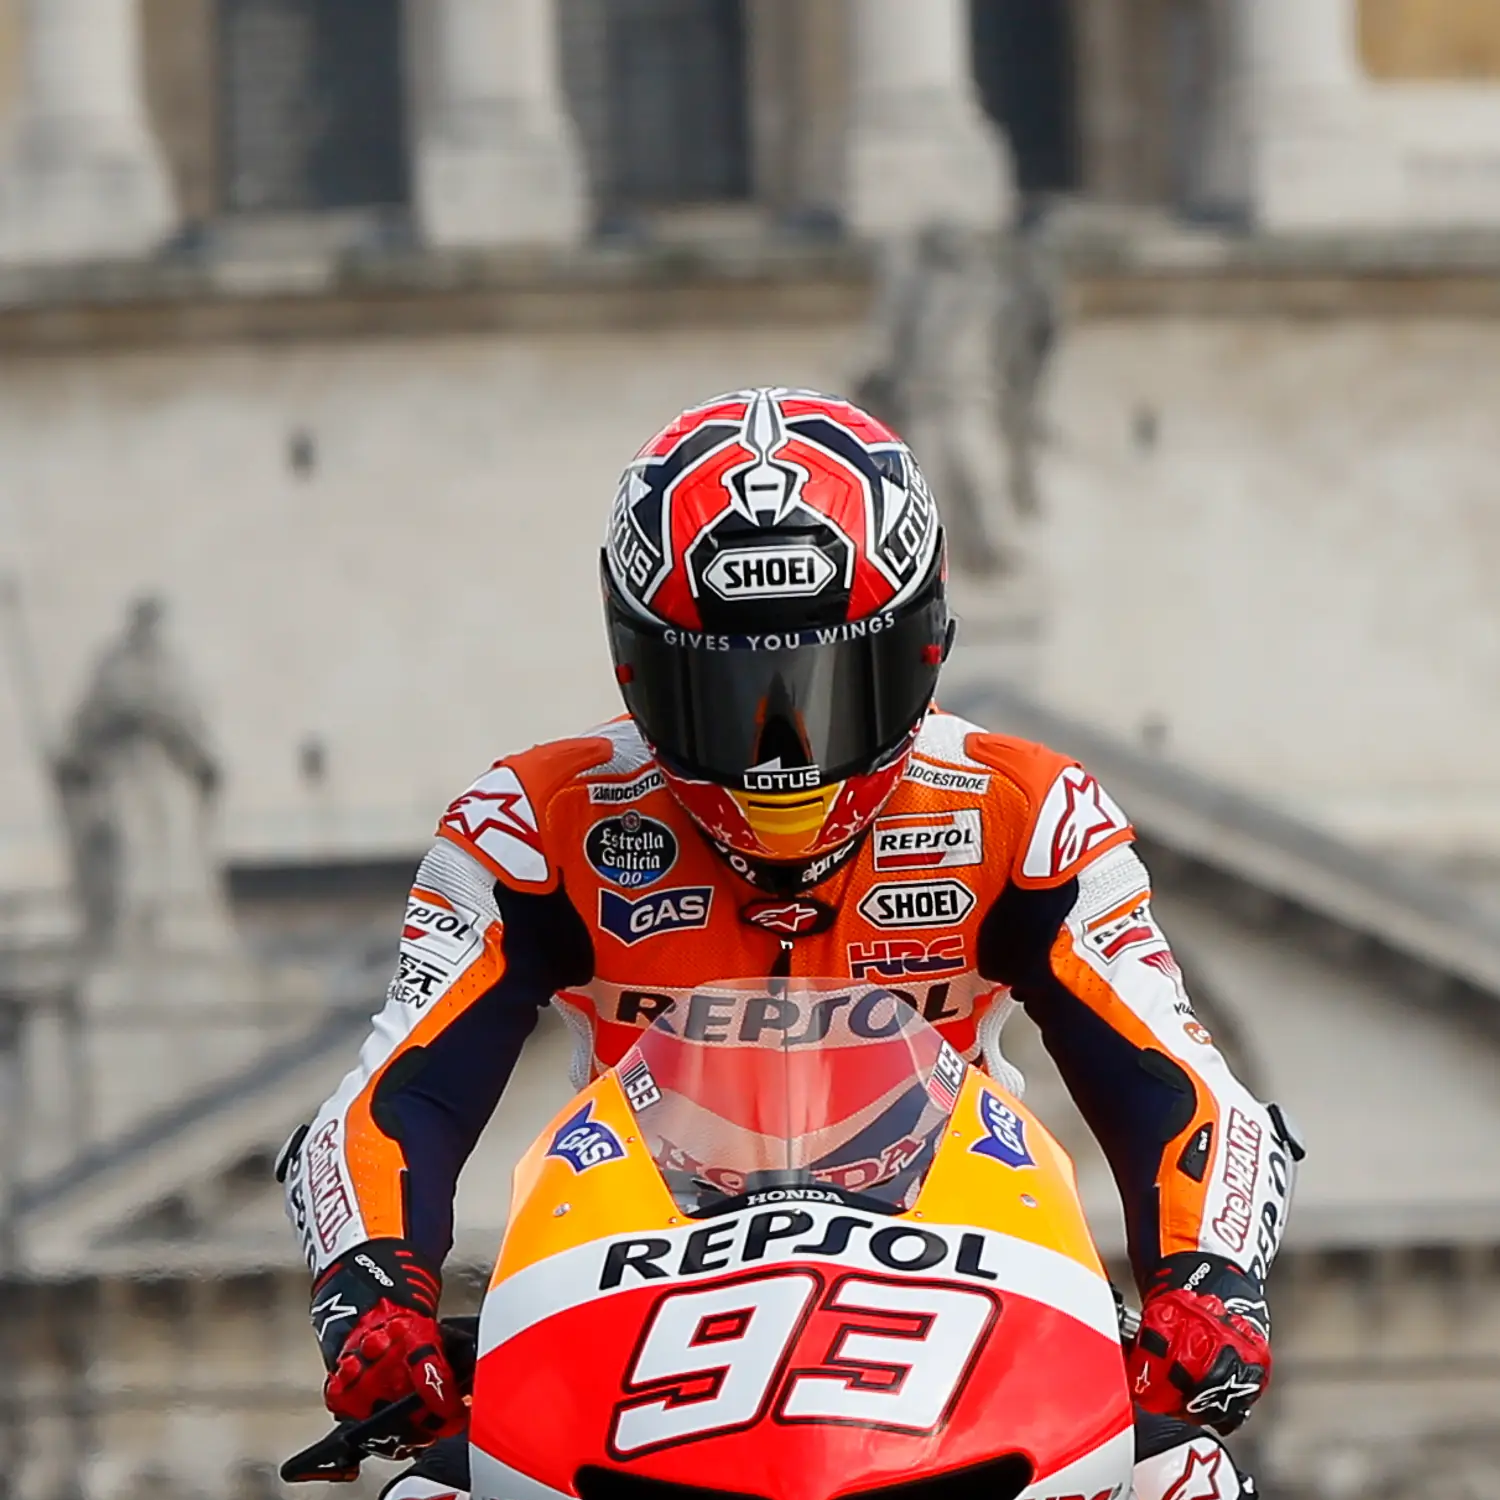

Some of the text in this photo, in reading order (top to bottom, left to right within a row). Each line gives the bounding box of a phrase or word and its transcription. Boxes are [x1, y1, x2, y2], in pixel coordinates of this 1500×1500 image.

[884, 466, 930, 575] LOTUS
[612, 492, 653, 588] OTUS
[723, 556, 816, 589] SHOEI
[663, 611, 895, 652] GIVES YOU WINGS
[592, 772, 665, 801] BRIDGESTO
[743, 770, 821, 790] LOTUS
[904, 764, 986, 790] IDGESTONE
[599, 828, 664, 851] Estrella
[602, 847, 660, 870] Galicia
[879, 829, 975, 851] REPSOL
[406, 902, 470, 941] PSOL
[630, 895, 705, 933] GAS
[877, 890, 959, 920] SHOEI
[847, 935, 967, 983] HRC
[616, 982, 960, 1044] REPSOL
[988, 1098, 1025, 1156] GAS
[556, 1127, 613, 1166] GAS
[747, 1188, 845, 1206] HONDA
[599, 1209, 999, 1291] REPSOL
[605, 1267, 1002, 1461] 93
